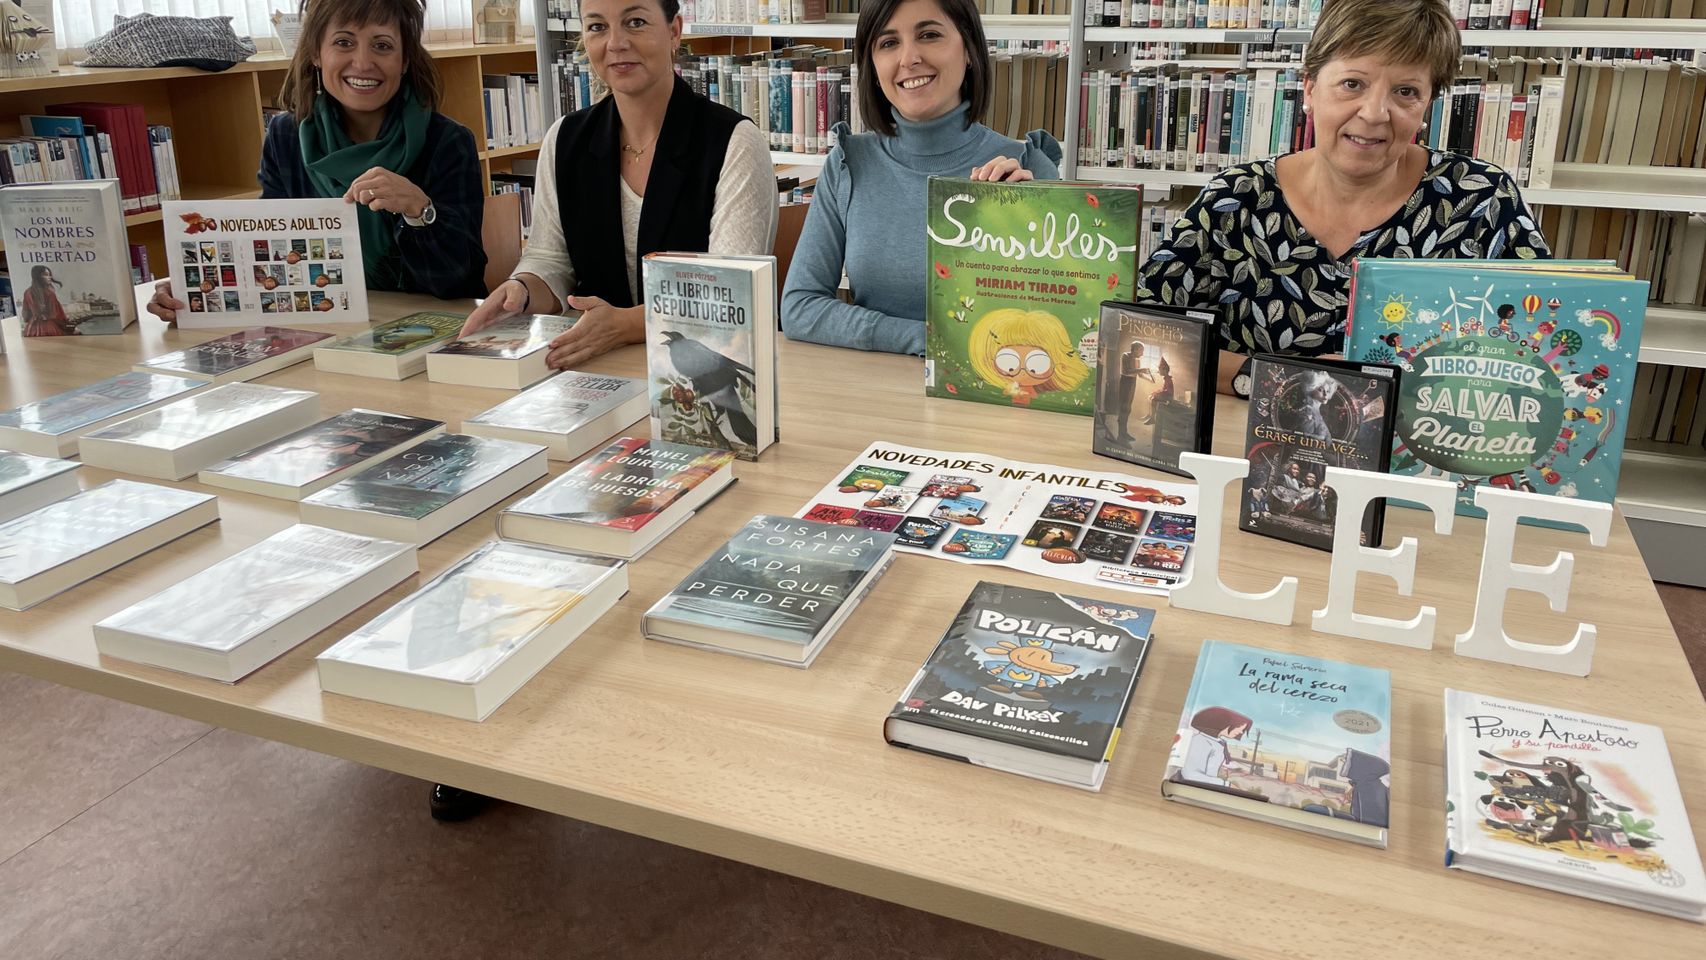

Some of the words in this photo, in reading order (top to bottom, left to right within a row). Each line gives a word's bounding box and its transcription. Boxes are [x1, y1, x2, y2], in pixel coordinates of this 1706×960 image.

[31, 217, 53, 225] LOS
[55, 217, 75, 225] MIL
[220, 218, 287, 232] NOVEDADES
[290, 217, 342, 231] ADULTOS
[932, 194, 1124, 262] Sensibles
[15, 226, 95, 239] NOMBRES
[41, 241, 55, 249] DE
[20, 251, 96, 263] LIBERTAD
[955, 260, 965, 268] Un
[965, 261, 991, 270] cuento
[991, 264, 1009, 272] para
[1010, 264, 1041, 275] abrazar
[1042, 267, 1049, 275] lo
[1051, 269, 1064, 278] que
[1065, 270, 1100, 280] sentimos
[660, 280, 673, 295] EL
[676, 281, 710, 300] LIBRO
[713, 286, 735, 303] DEL
[975, 277, 1025, 291] MIRIAM
[1028, 282, 1078, 296] TIRADO
[653, 294, 745, 325] SEPULTURERO
[1118, 313, 1184, 342] PINOCHO
[1463, 341, 1475, 353] el
[1477, 343, 1507, 356] gran
[1431, 357, 1536, 384] LIBRO-JUEGO
[1467, 378, 1492, 388] para
[1415, 386, 1542, 424] SALVAR
[1254, 423, 1297, 444] ÉRASE
[1409, 416, 1537, 455] Planeta
[1470, 422, 1484, 433] EL
[606, 455, 692, 472] LOUREIRO
[632, 447, 690, 461] MANEL
[600, 472, 684, 490] LADRONA
[868, 449, 995, 474] NOVEDADES
[999, 467, 1128, 494] INFANTILES
[588, 481, 660, 499] HUESOS
[752, 520, 875, 546] SUSANA
[746, 532, 862, 557] FORTES
[719, 553, 801, 574] NADA
[687, 581, 820, 613] PERDER
[777, 579, 838, 597] QUE
[978, 609, 1120, 652] POLICÁN
[1238, 663, 1257, 677] La
[1264, 671, 1304, 685] rama
[1310, 680, 1348, 693] seca
[940, 690, 989, 711] DAV
[1249, 678, 1279, 694] del
[1282, 688, 1338, 703] cerezo
[940, 711, 976, 723] creador
[976, 718, 991, 726] del
[992, 721, 1028, 733] Capitán
[1029, 729, 1089, 747] Calzoncillos
[1345, 718, 1370, 727] 2021
[1465, 715, 1532, 739] Perro
[1538, 718, 1640, 750] Apestoso
[1512, 739, 1521, 749] y
[1525, 739, 1541, 747] su
[1543, 741, 1602, 752] pandilla
